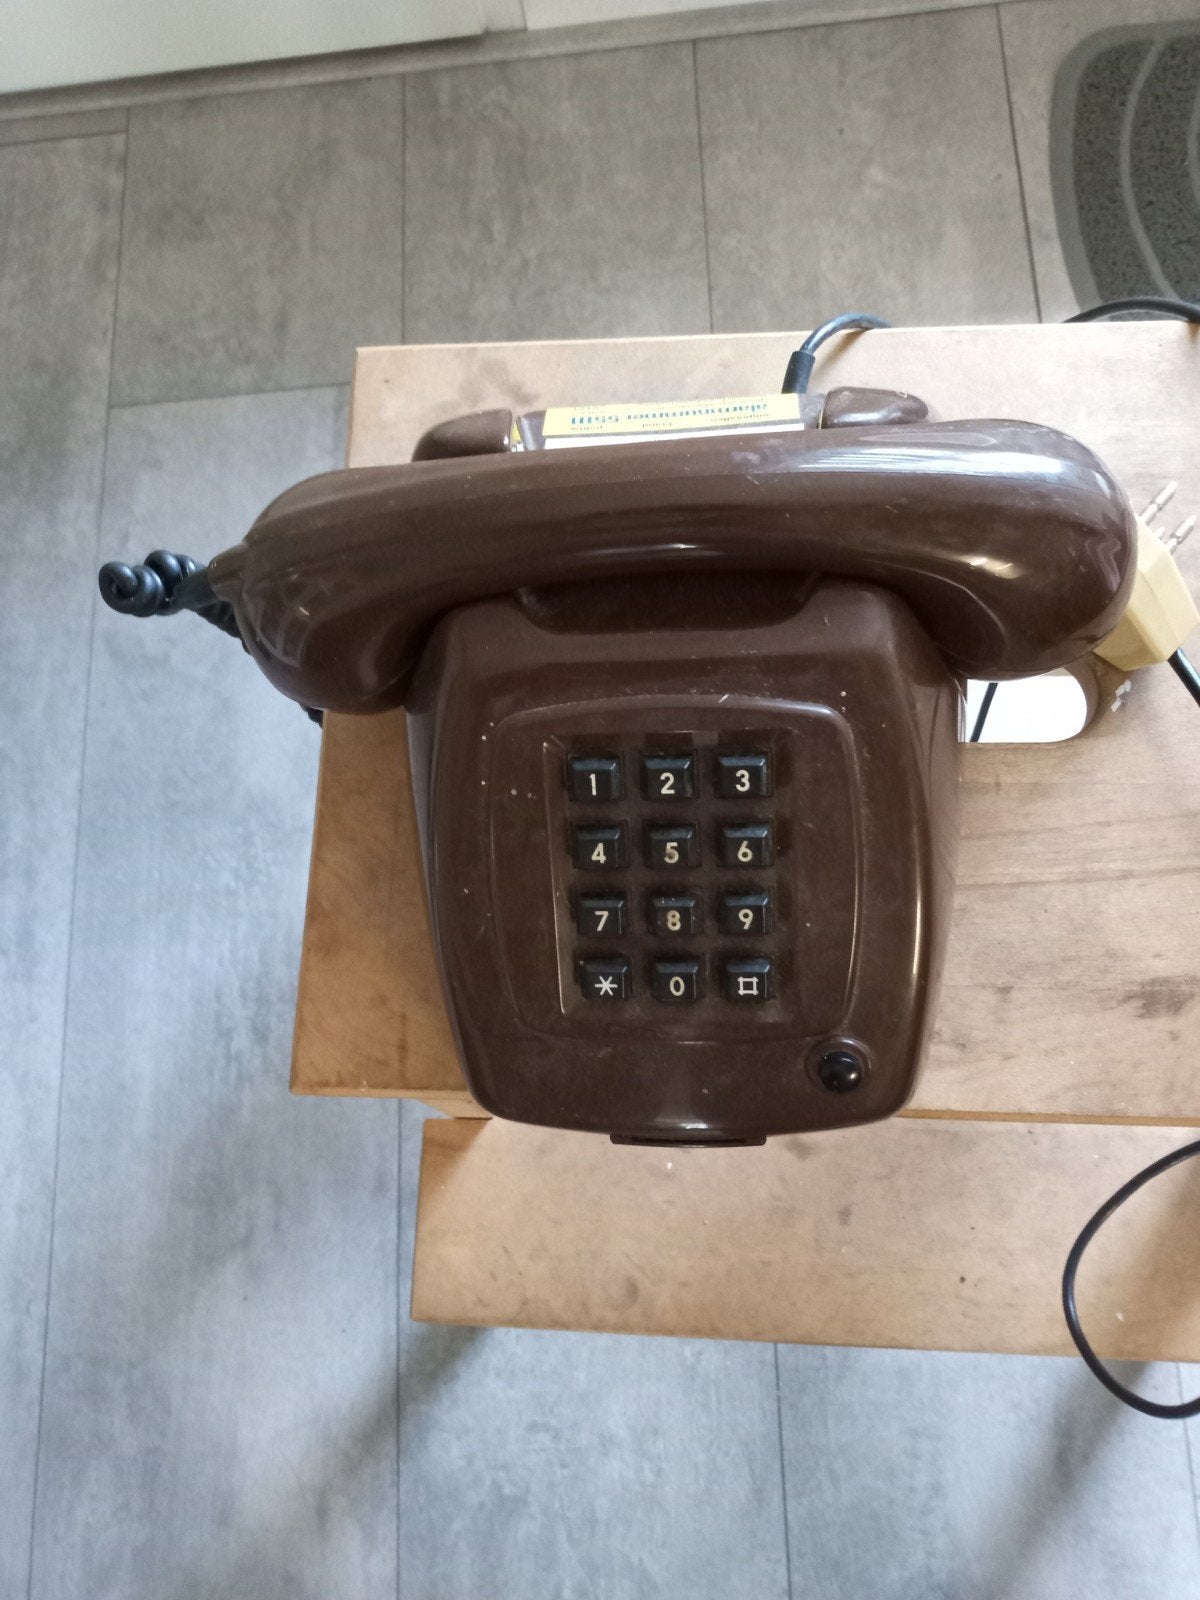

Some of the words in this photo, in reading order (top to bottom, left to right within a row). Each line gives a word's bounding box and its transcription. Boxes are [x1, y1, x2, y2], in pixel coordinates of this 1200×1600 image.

[627, 404, 768, 420] alarmnummer
[589, 773, 597, 796] 1
[659, 772, 675, 795] 2
[735, 769, 750, 792] 3
[591, 842, 607, 864] 4
[663, 841, 680, 864] 5
[737, 840, 753, 862] 6
[594, 910, 609, 932] 7
[666, 909, 682, 931] 8
[738, 908, 754, 930] 9
[669, 976, 685, 997] 0
